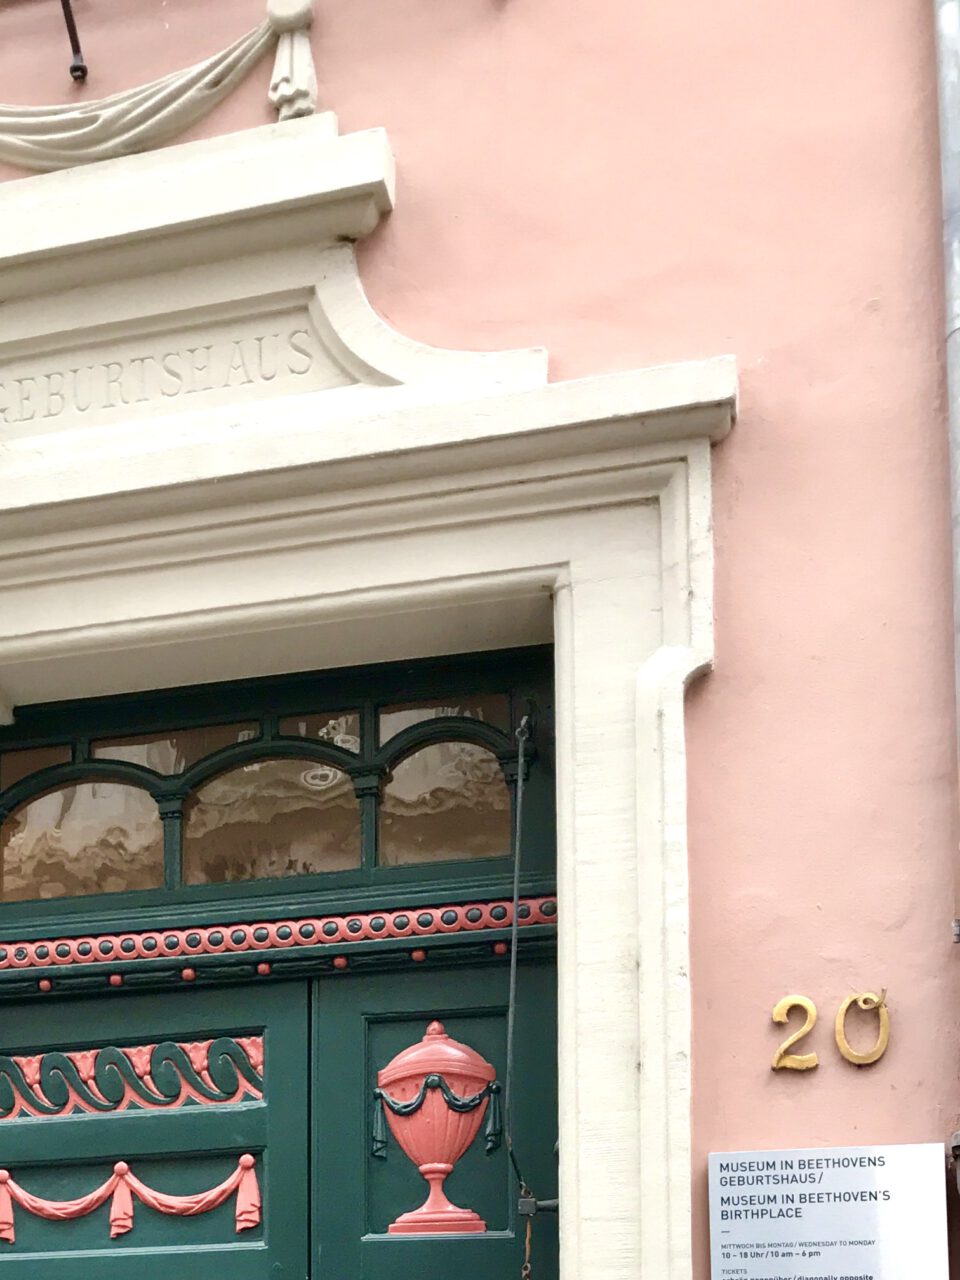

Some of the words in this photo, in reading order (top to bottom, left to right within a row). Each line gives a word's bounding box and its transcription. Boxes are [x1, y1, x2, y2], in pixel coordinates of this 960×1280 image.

[771, 992, 890, 1071] 20
[719, 1161, 776, 1173] MUSEUM
[780, 1160, 794, 1170] IN
[798, 1156, 886, 1170] BEETHOVENS
[720, 1195, 777, 1206] MUSEUM
[781, 1194, 794, 1204] IN
[799, 1190, 891, 1204] BEETHOVEN'S
[721, 1207, 803, 1221] BIRTHPLACE
[740, 1251, 748, 1259] 18
[750, 1251, 764, 1259] Uhr
[771, 1250, 780, 1258] 10
[802, 1249, 807, 1257] 6
[809, 1251, 821, 1259] pm
